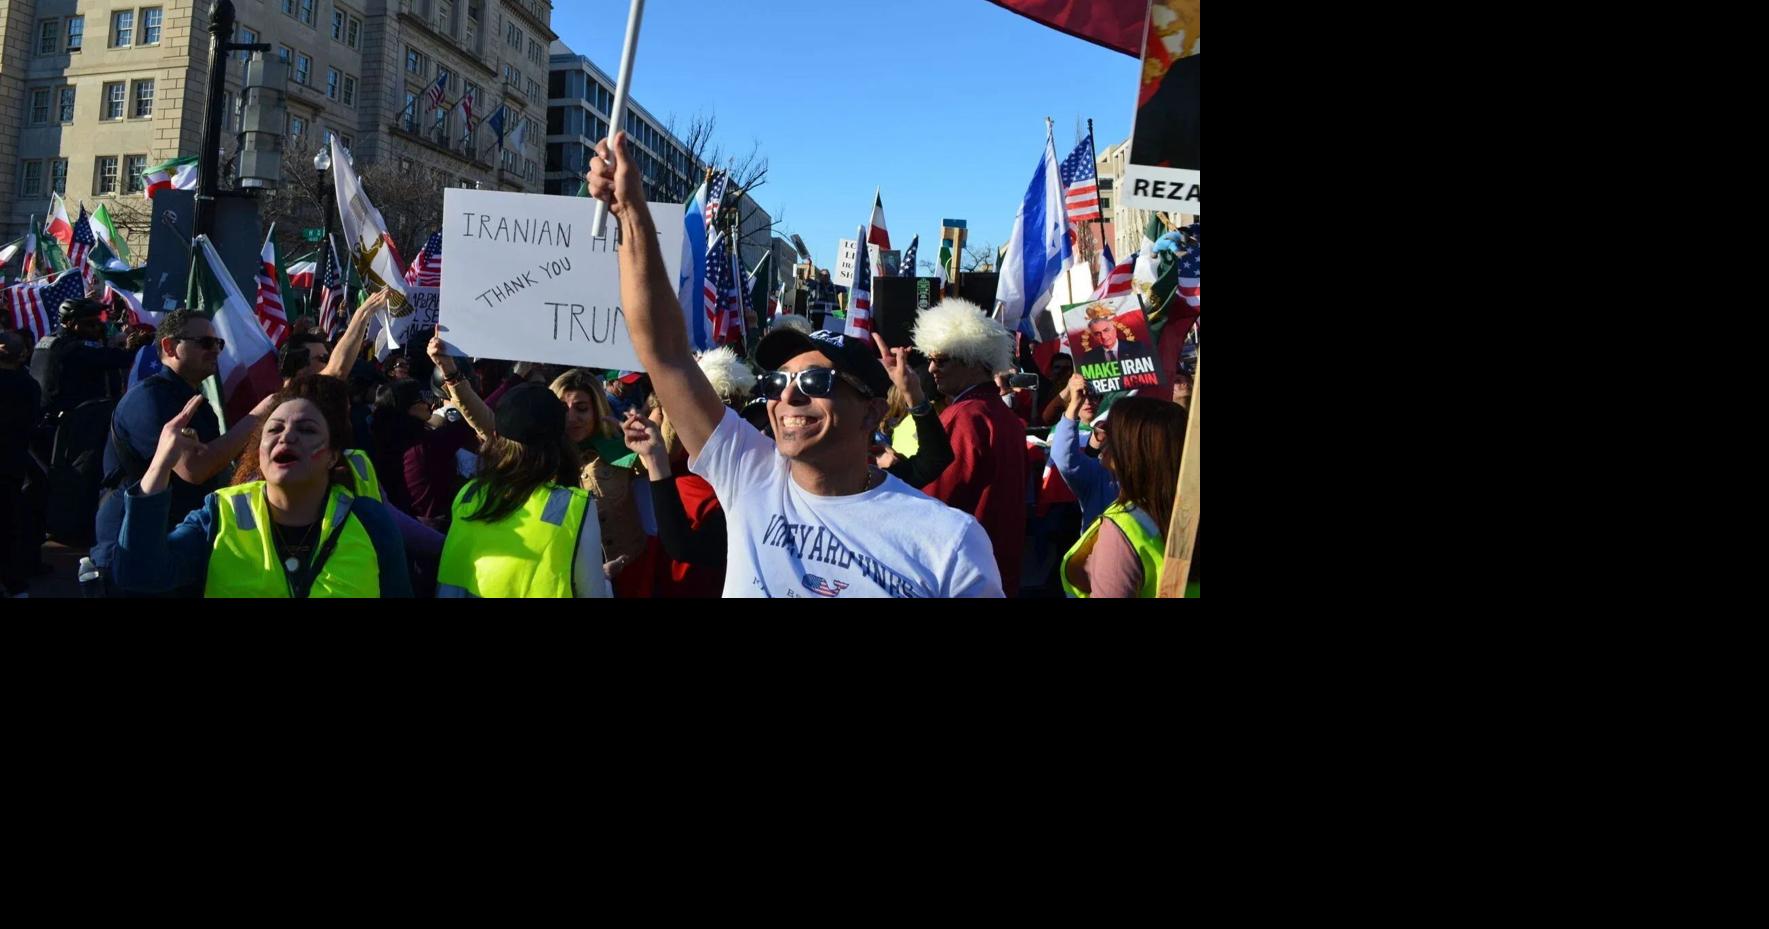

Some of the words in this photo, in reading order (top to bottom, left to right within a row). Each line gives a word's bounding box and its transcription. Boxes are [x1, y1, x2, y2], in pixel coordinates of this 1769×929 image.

[1133, 178, 1200, 203] REZA
[462, 212, 572, 249] IRANIAN
[475, 271, 538, 309] THANK
[539, 256, 572, 280] YOU
[1080, 361, 1121, 380] MAKE
[1120, 356, 1155, 375] IRAN
[1092, 377, 1121, 393] REAT
